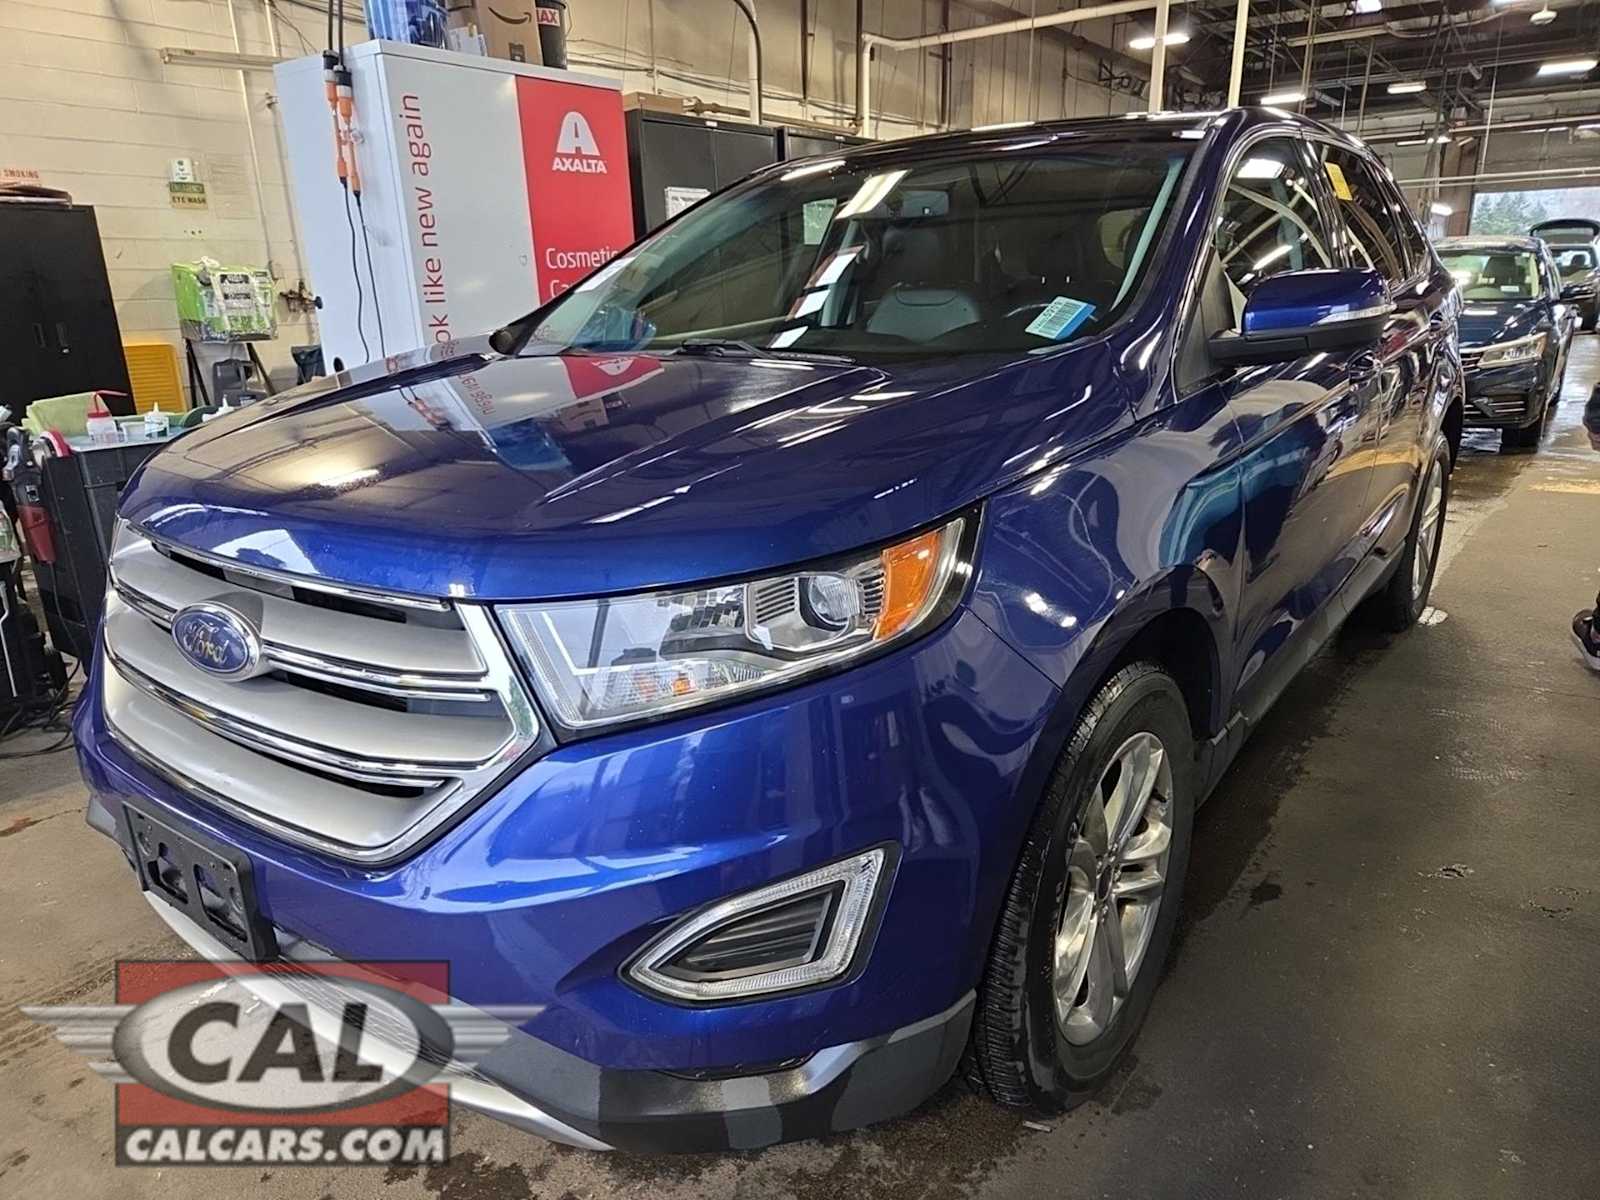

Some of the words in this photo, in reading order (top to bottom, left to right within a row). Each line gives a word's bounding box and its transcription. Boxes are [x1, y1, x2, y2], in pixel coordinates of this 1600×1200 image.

[399, 95, 432, 176] again
[552, 157, 608, 174] AXALTA
[415, 187, 438, 247] new
[423, 258, 446, 303] like
[428, 314, 451, 343] ok
